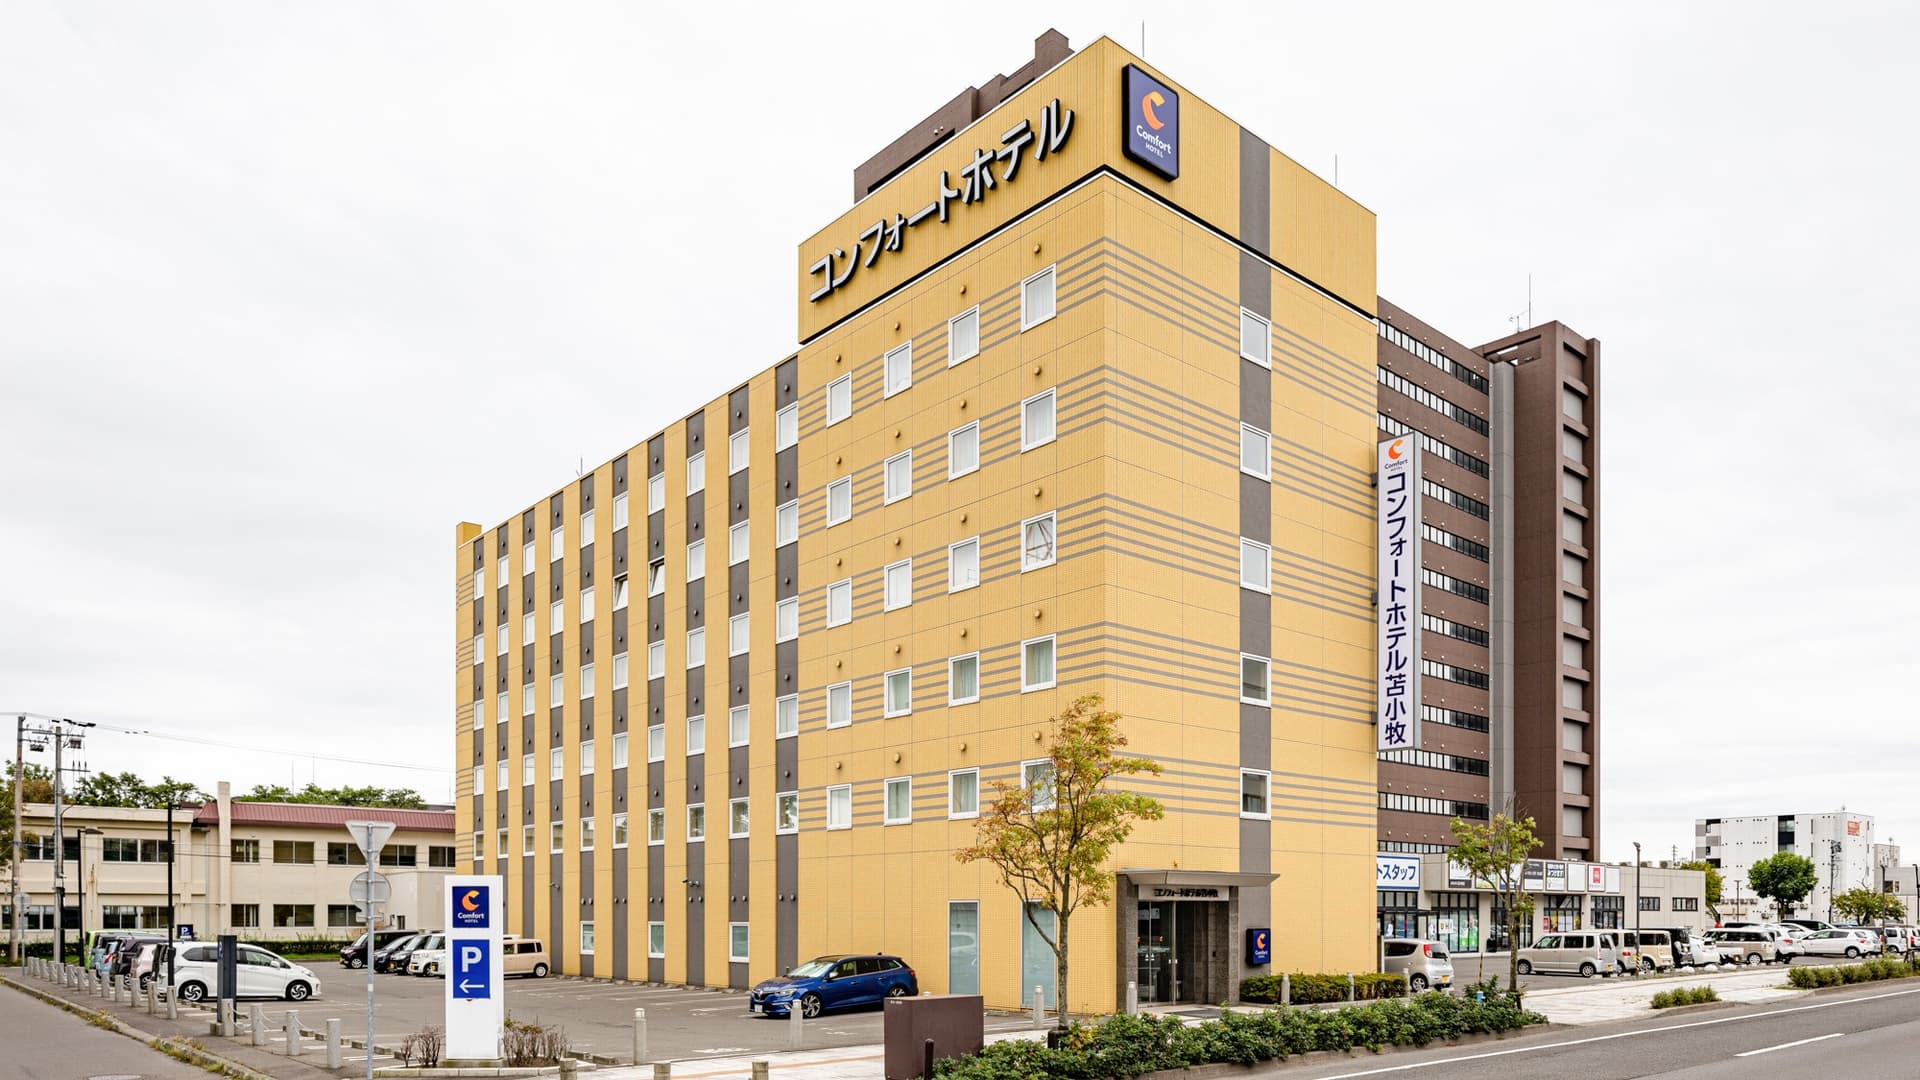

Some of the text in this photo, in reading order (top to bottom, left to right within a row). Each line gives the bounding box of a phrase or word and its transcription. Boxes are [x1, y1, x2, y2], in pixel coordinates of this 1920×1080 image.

[1136, 124, 1172, 154] Comfort
[1145, 142, 1164, 158] HOTEL
[809, 98, 1075, 303] コンフォートホテル
[1385, 472, 1408, 746] コンフォートホテル苫小牧
[457, 911, 485, 920] Comfort
[461, 946, 482, 973] P
